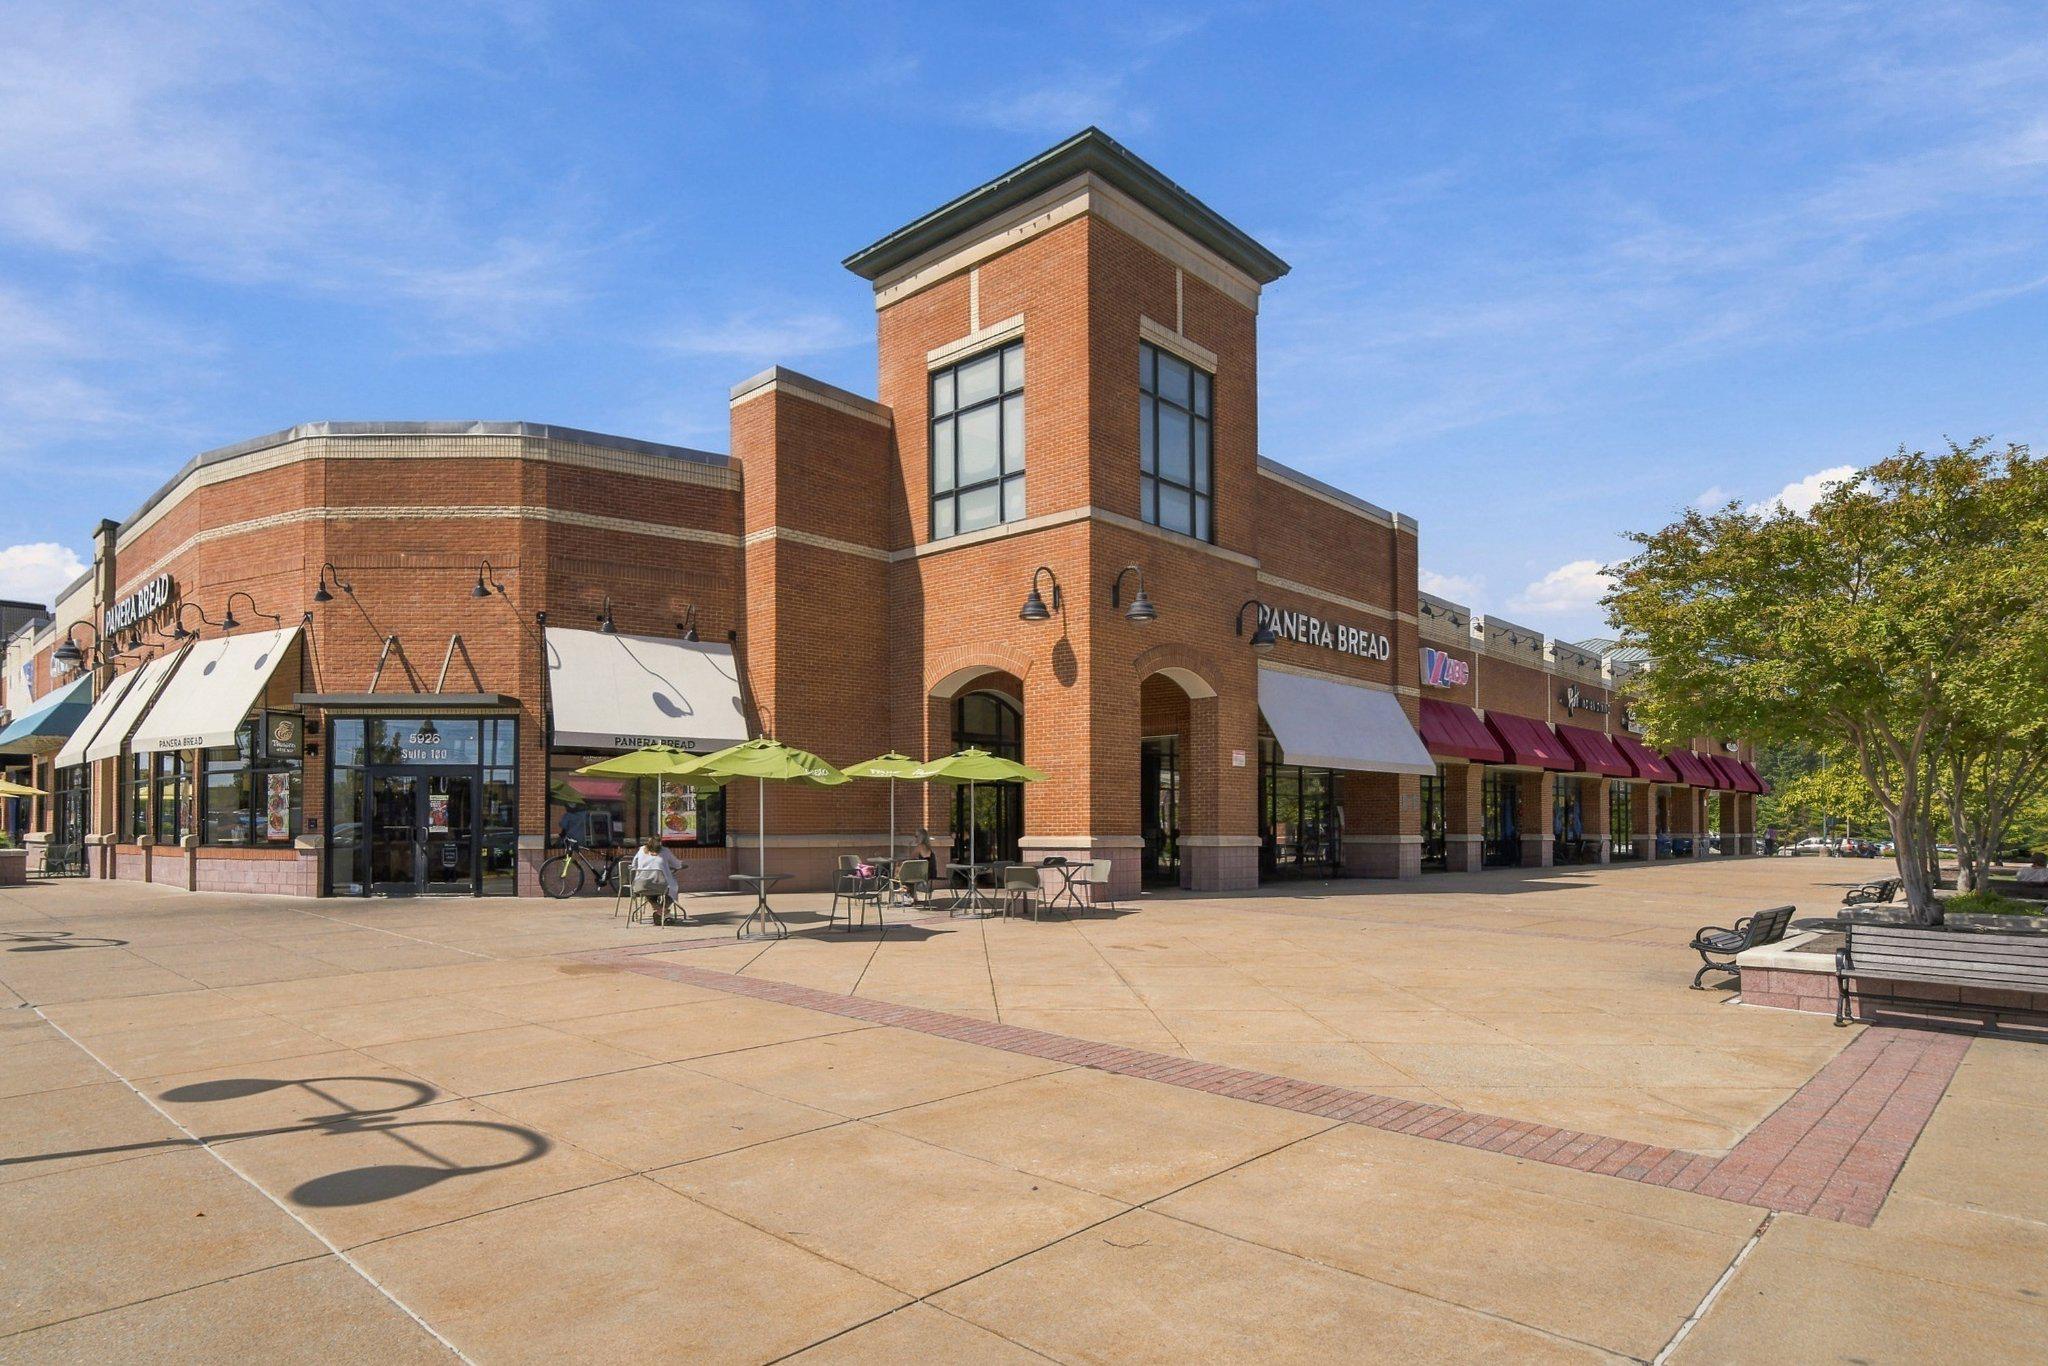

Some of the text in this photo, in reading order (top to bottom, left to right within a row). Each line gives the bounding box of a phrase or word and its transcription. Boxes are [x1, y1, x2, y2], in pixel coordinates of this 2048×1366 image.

[105, 573, 170, 638] PANERA BREAD
[1259, 603, 1390, 661] PANERA BREAD
[409, 733, 441, 744] 5926
[614, 737, 657, 747] PANERA
